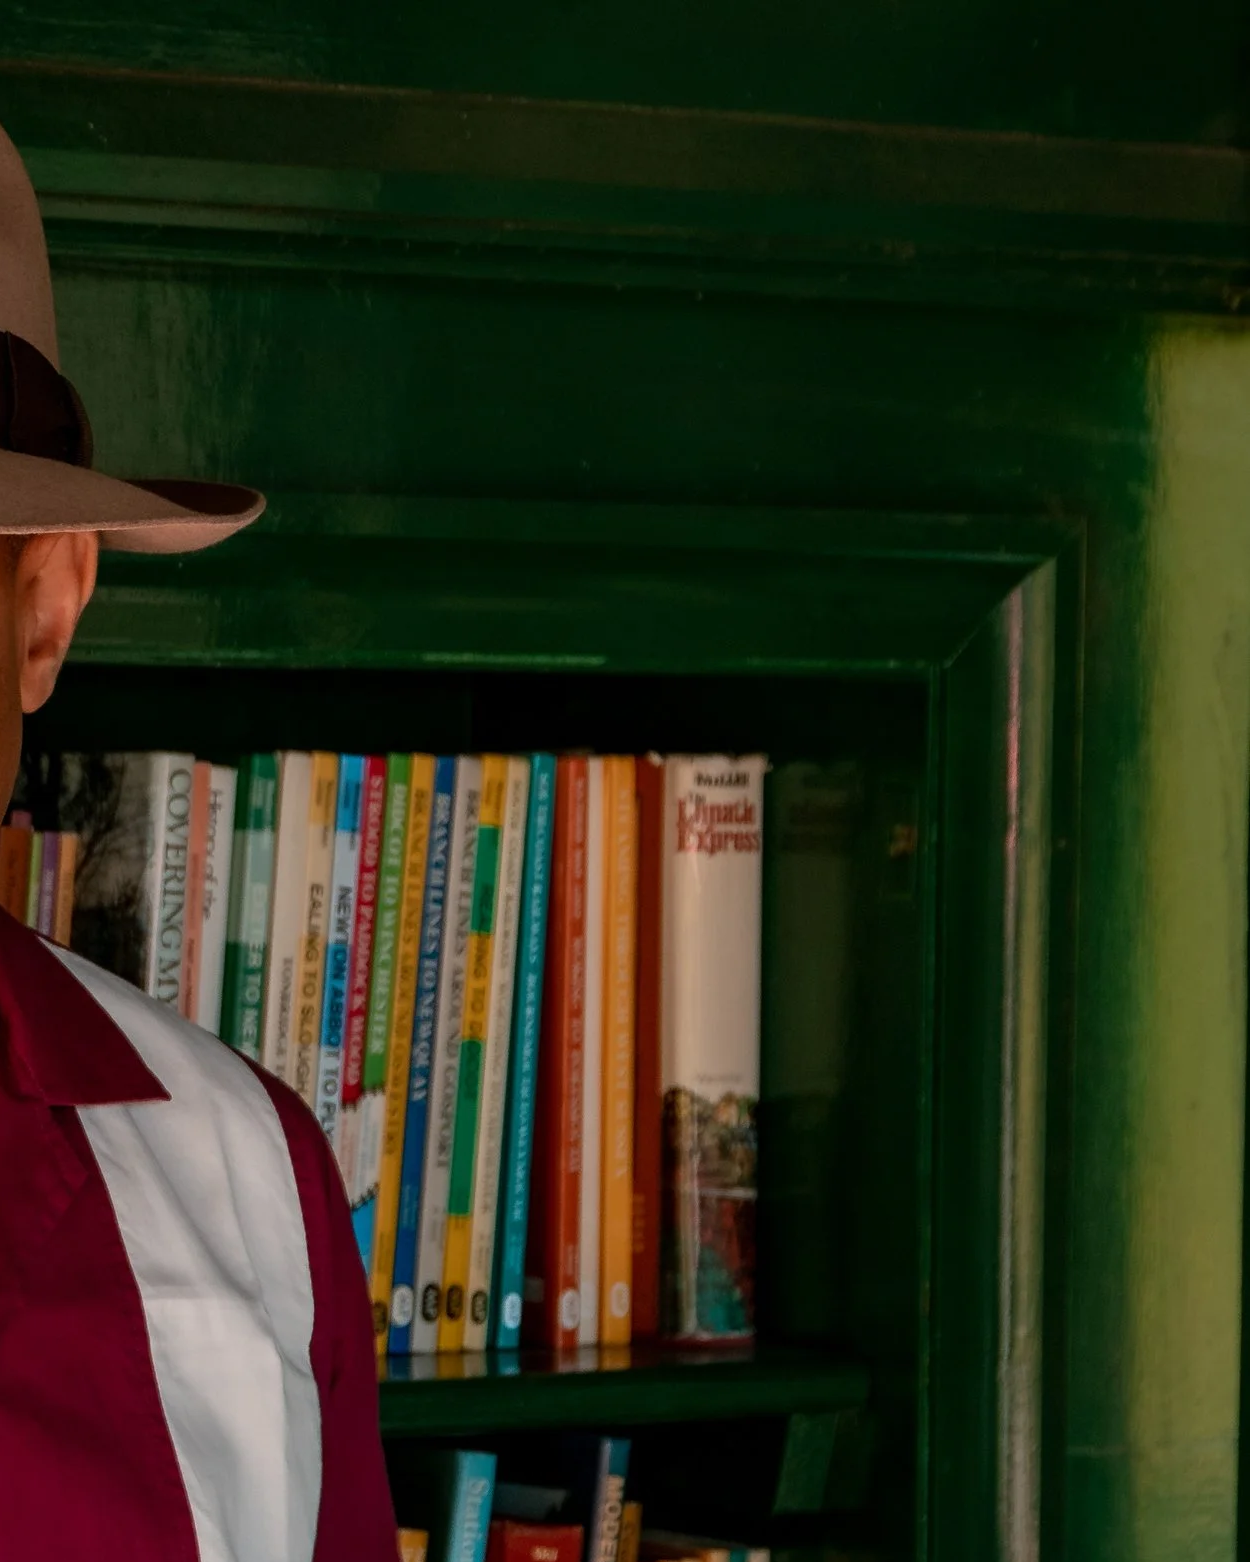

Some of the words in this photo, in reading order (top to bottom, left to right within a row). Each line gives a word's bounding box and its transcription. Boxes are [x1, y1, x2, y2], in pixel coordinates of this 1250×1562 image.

[159, 767, 193, 949] COVERING
[360, 774, 384, 867] STROOD
[385, 782, 408, 867] DIDCOT
[406, 788, 429, 877] BRANCH
[426, 791, 453, 884] BRANCH
[459, 788, 480, 883] BRANCH
[677, 829, 760, 857] Express
[303, 882, 324, 961] EALING
[358, 871, 377, 895] TO
[381, 874, 400, 906] TO
[400, 882, 421, 945] LINES
[420, 886, 444, 954] LINES
[452, 890, 471, 955] LINES
[329, 885, 352, 982] NEWTON
[350, 904, 374, 1013] PADDOCK
[419, 958, 438, 980] TO
[471, 882, 494, 981] READING
[155, 956, 181, 1003] MY
[243, 972, 262, 1003] TO
[300, 971, 318, 998] TO
[368, 910, 397, 1056] WINCHESTER
[443, 965, 465, 1059] AROUND
[469, 985, 485, 1013] TO
[293, 1004, 316, 1093] SLOUGH
[324, 987, 345, 1058] ABBOT
[344, 1016, 365, 1086] WOOD
[408, 979, 438, 1103] NEWQUAY
[321, 1067, 339, 1096] TO
[433, 1063, 457, 1170] GOSPORT
